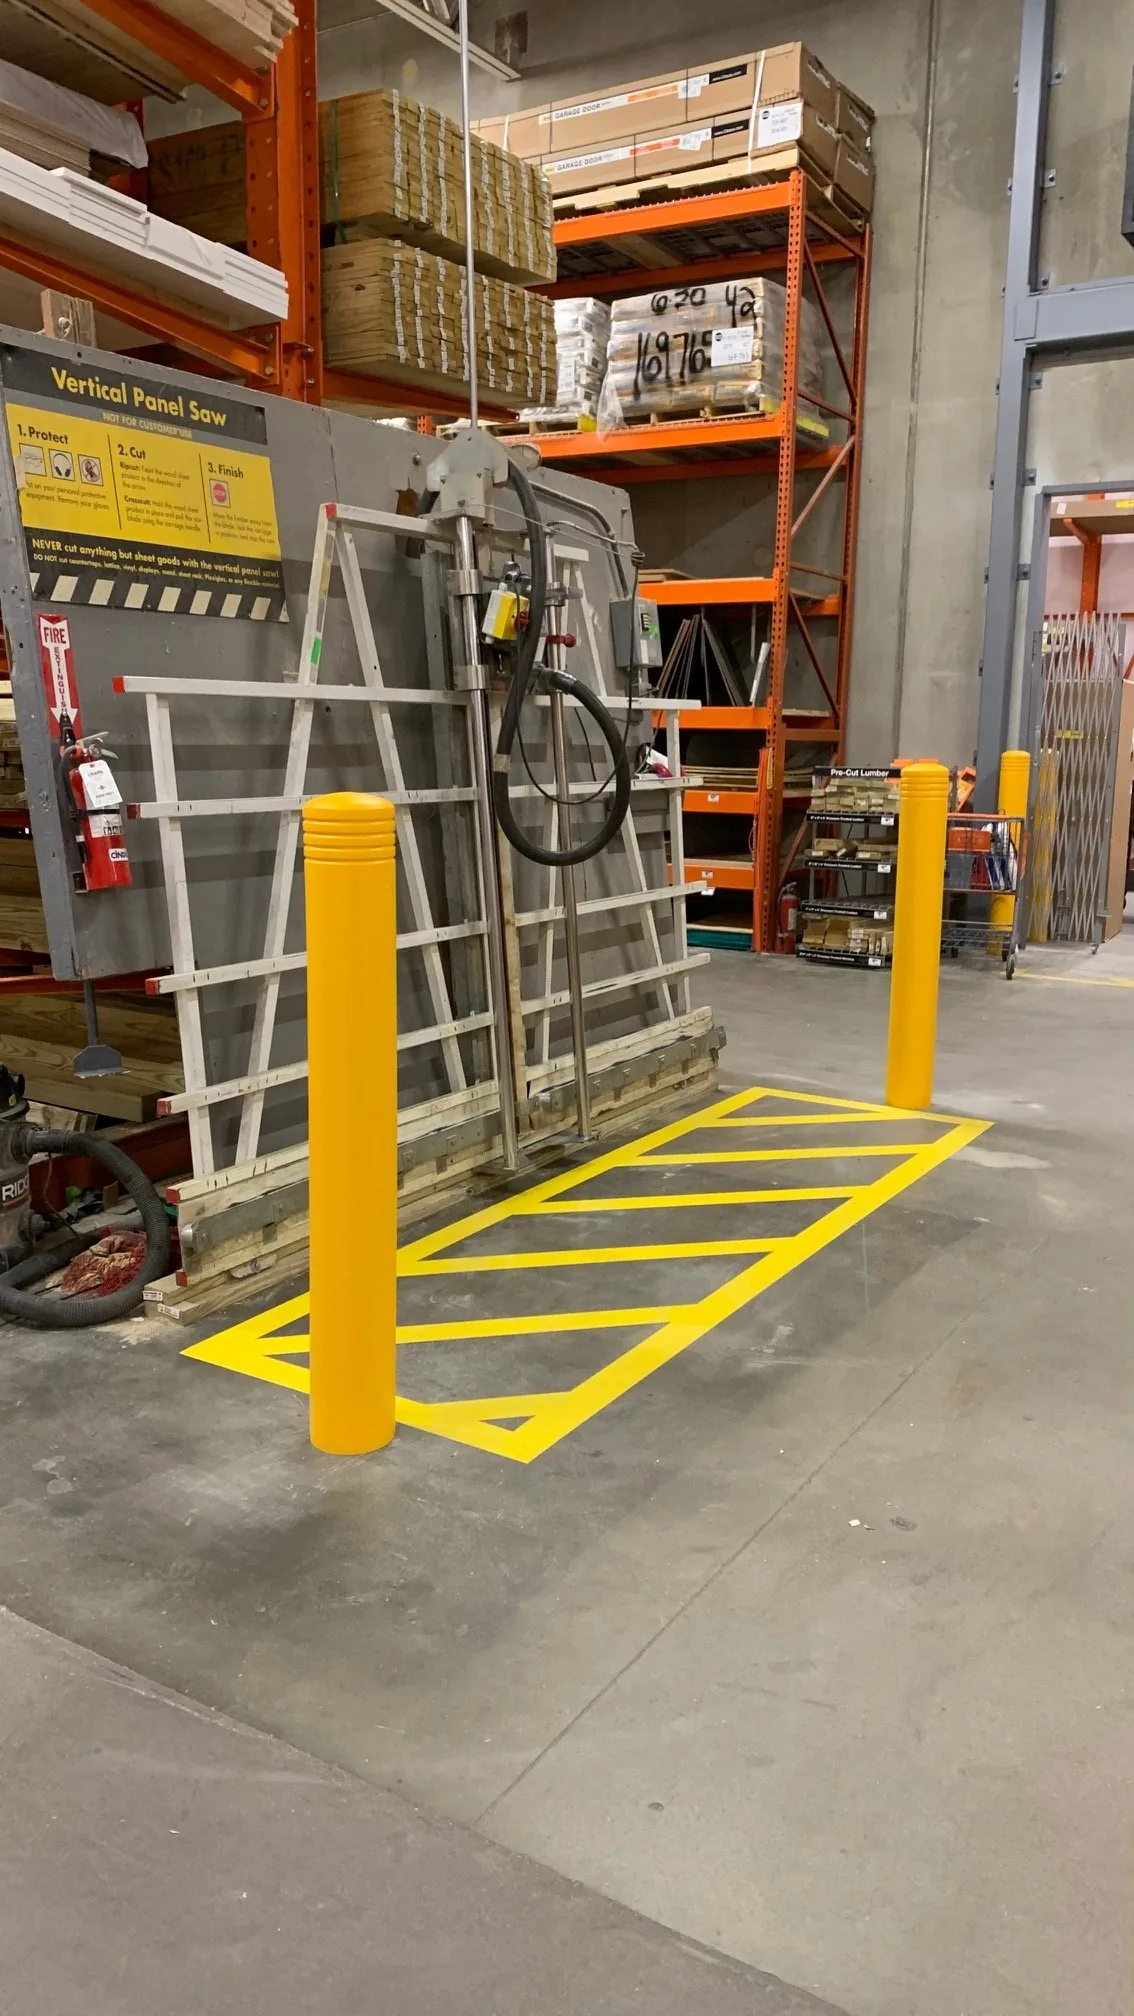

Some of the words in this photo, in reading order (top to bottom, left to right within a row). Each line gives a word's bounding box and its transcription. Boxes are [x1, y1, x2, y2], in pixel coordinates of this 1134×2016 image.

[555, 108, 580, 119] GARAGE
[582, 103, 600, 113] DOOR
[557, 160, 582, 171] GARAGE
[584, 155, 603, 165] DOOR
[51, 367, 127, 404] Vertical
[133, 387, 184, 417] Panel
[189, 400, 227, 427] Saw
[102, 412, 120, 422] NOT
[121, 416, 137, 426] FOR
[139, 419, 179, 435] CUSTOMER
[28, 426, 69, 444] Protect
[129, 446, 146, 460] Cut
[218, 464, 244, 479] Finish
[32, 538, 62, 551] NEVER
[64, 544, 77, 553] cut
[79, 546, 117, 560] anything
[119, 548, 132, 559] but
[134, 551, 155, 563] sheet
[157, 555, 180, 566] goods
[182, 558, 199, 569] with
[200, 560, 212, 570] the
[213, 562, 240, 573] vertical
[242, 567, 261, 577] panel
[44, 554, 57, 562] NOT
[43, 626, 66, 645] FIRE
[830, 768, 859, 777] Pre-Cut
[860, 769, 889, 777] Lumber
